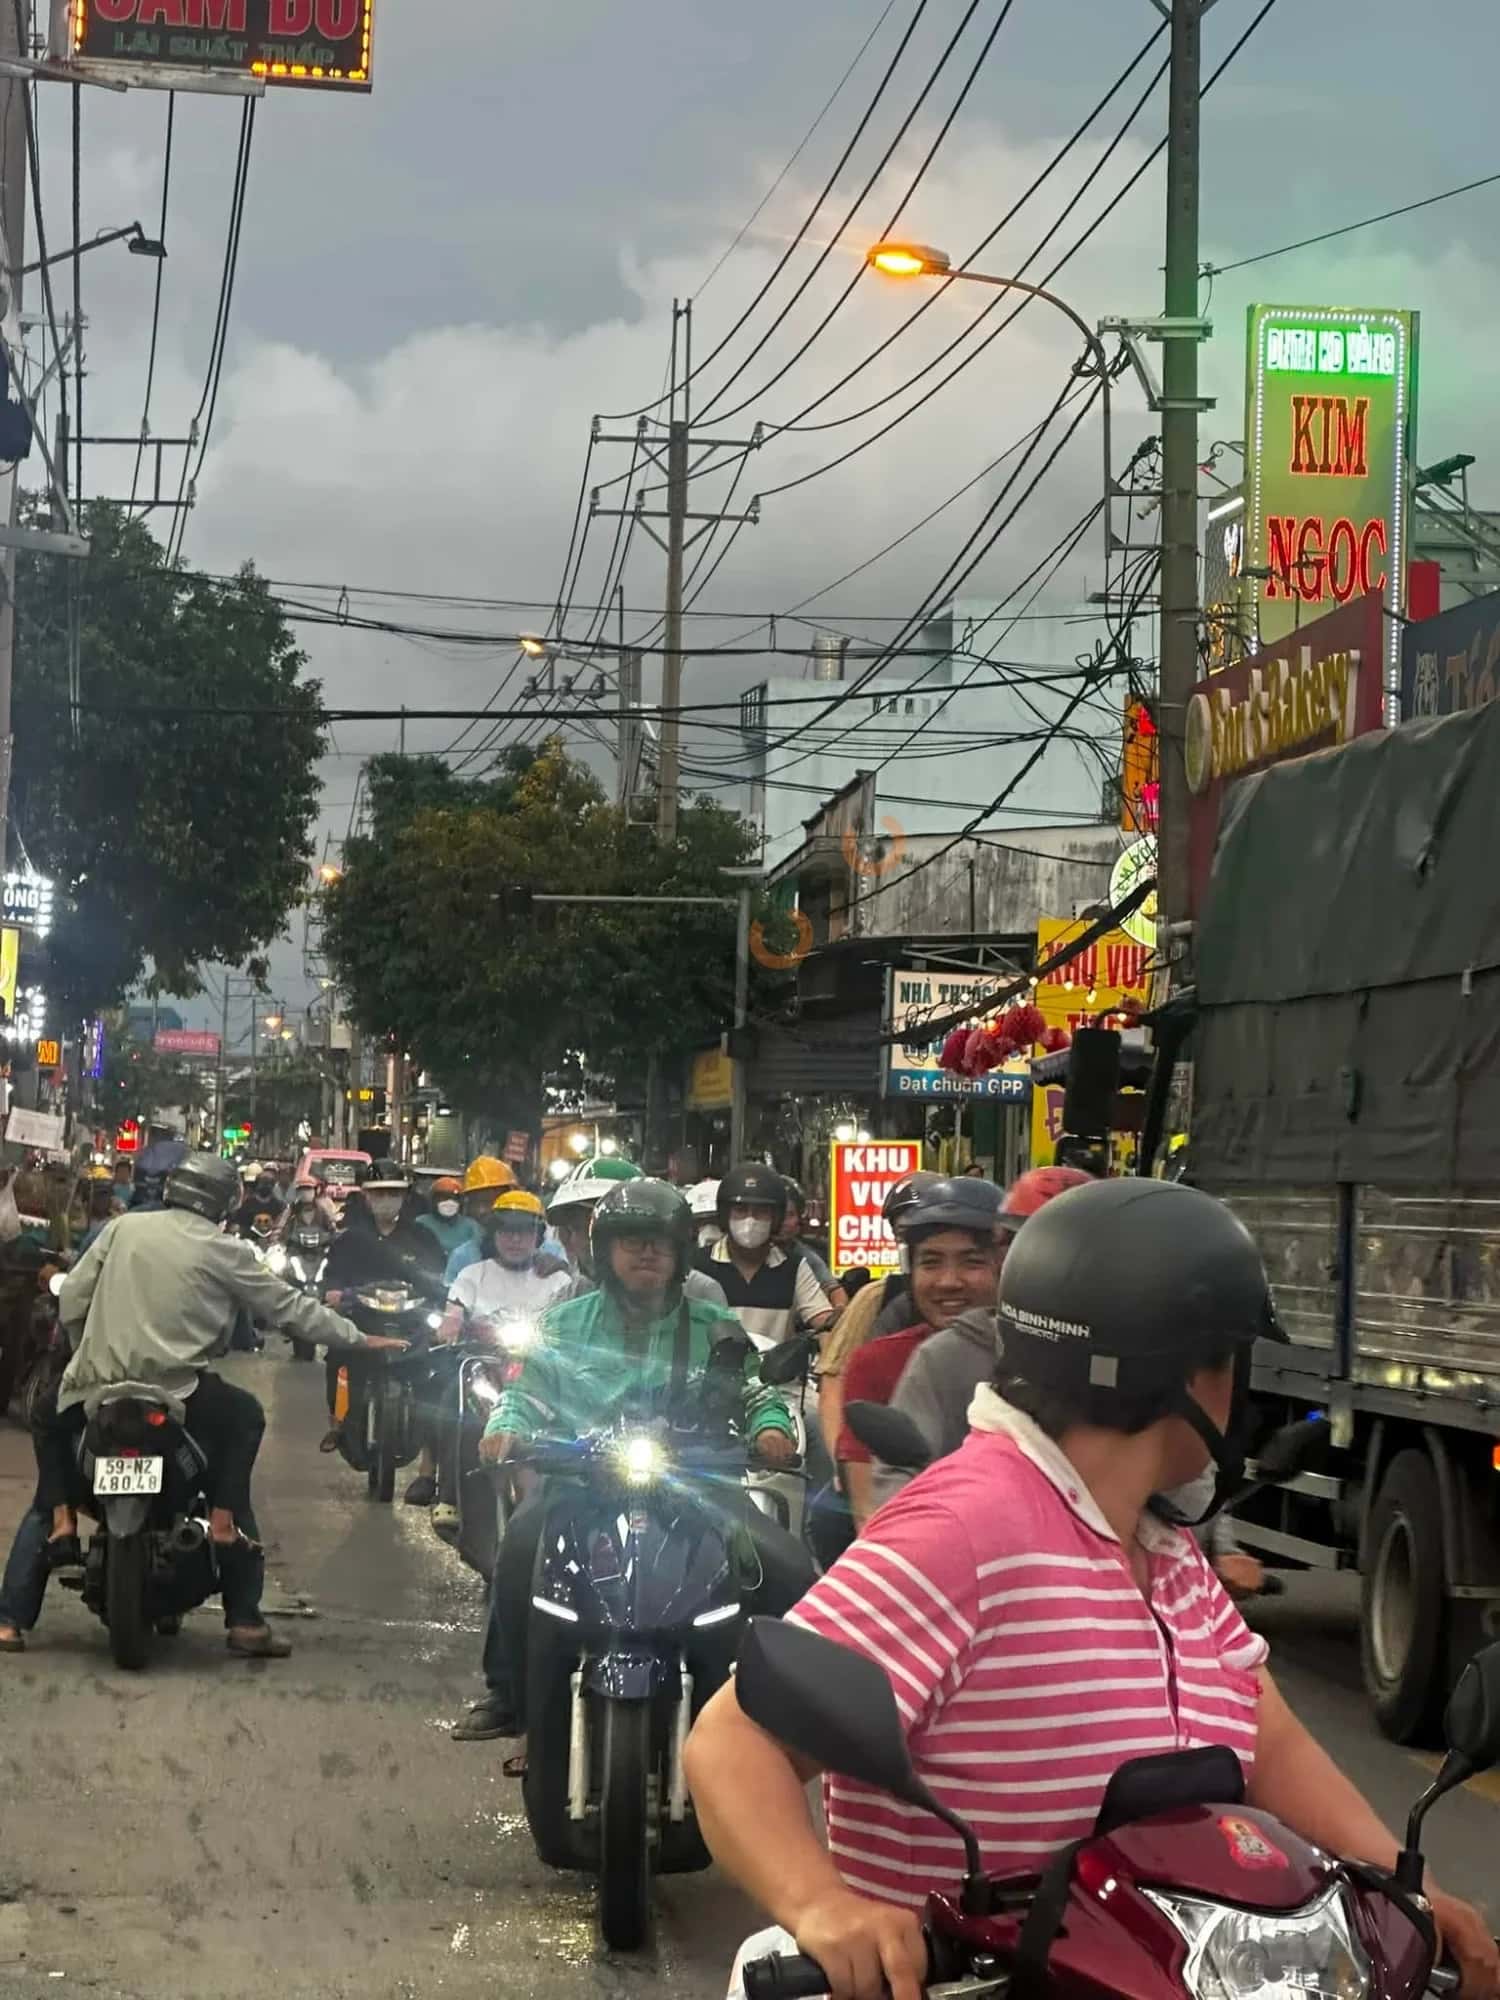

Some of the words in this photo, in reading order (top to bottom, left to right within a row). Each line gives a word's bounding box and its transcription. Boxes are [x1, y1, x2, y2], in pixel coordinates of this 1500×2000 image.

[1291, 395, 1369, 477] KIM
[900, 976, 932, 1004] NHÀ
[899, 1075, 928, 1094] Đạt
[987, 1078, 1024, 1096] GPP
[844, 1148, 910, 1173] KHU
[851, 1181, 894, 1208] VU
[1048, 1318, 1090, 1338] MINH
[105, 1459, 153, 1475] 59-N2
[97, 1476, 158, 1492] 480.48
